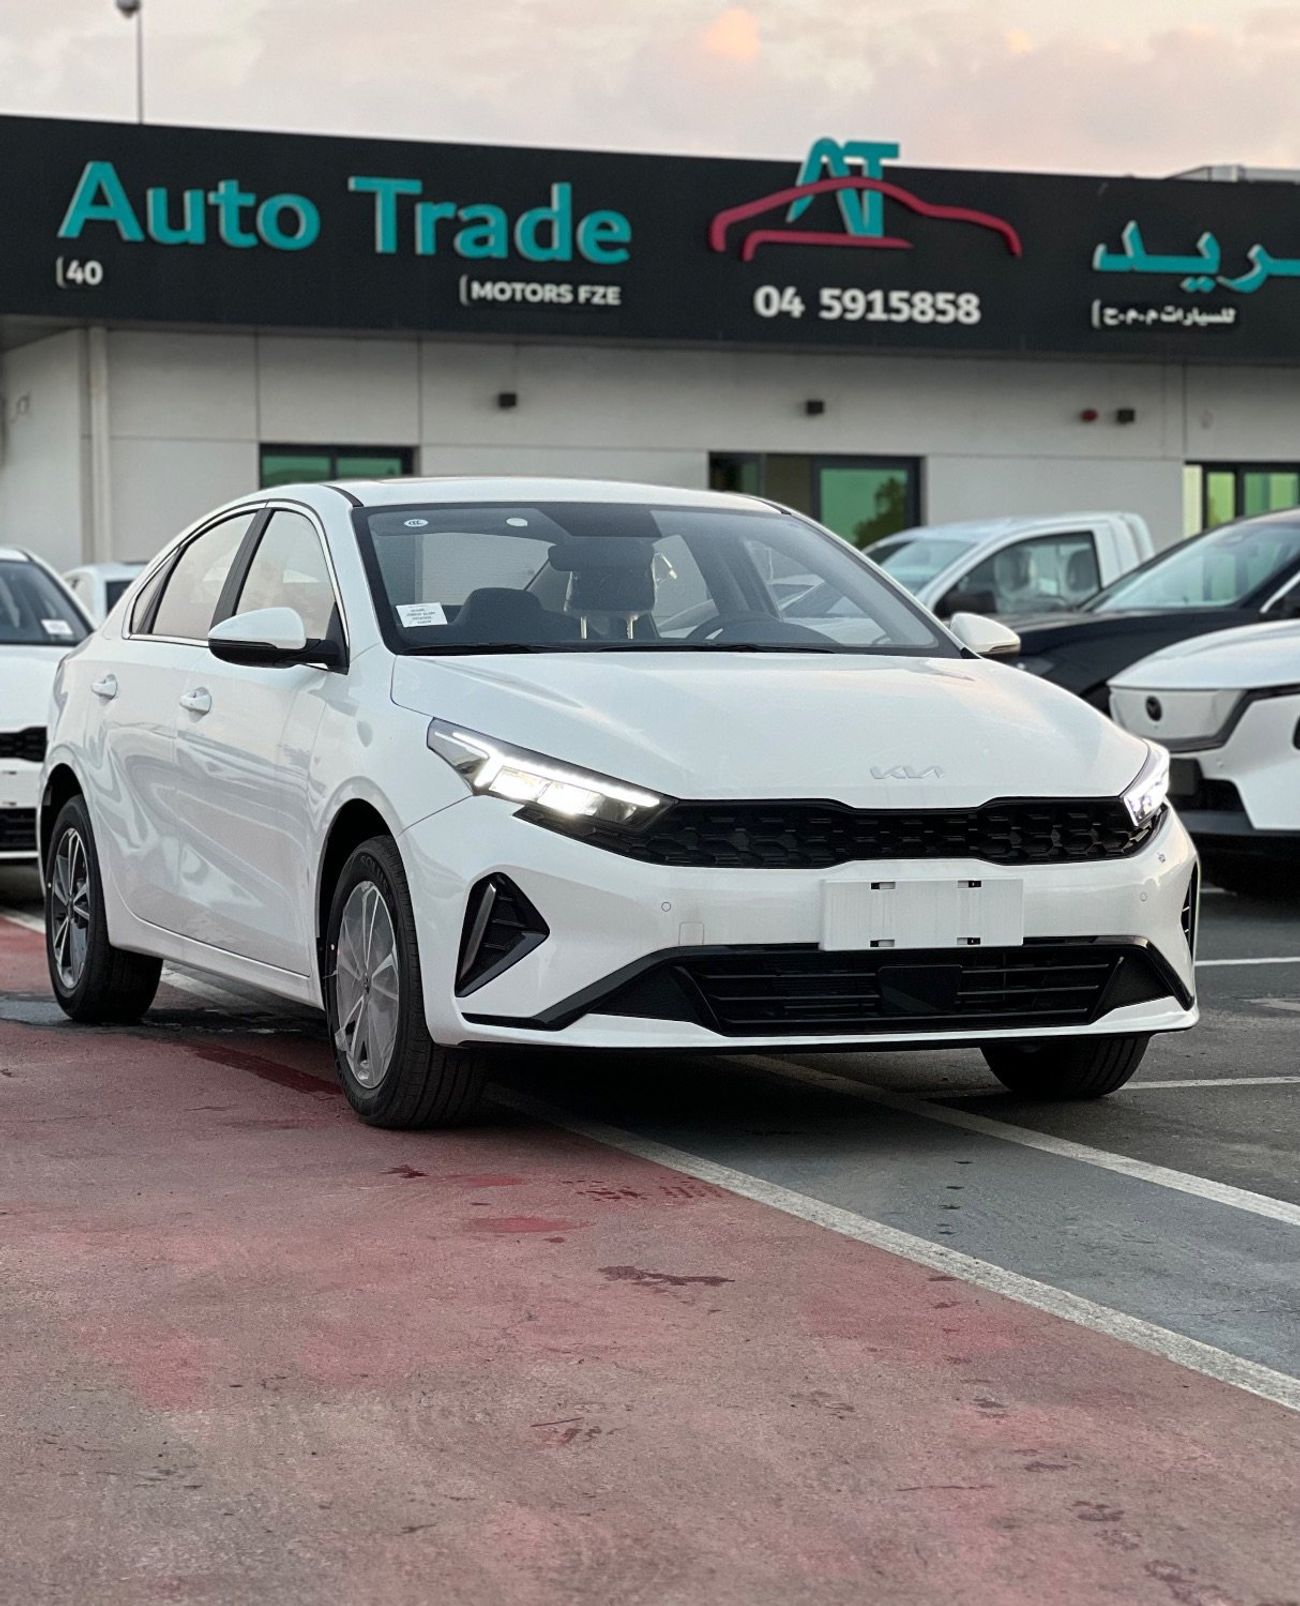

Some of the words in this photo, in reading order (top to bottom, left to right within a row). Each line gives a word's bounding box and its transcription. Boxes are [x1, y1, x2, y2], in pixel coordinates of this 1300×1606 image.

[58, 160, 320, 251] Auto
[348, 175, 632, 265] Trade
[788, 138, 899, 236] AT
[578, 285, 621, 306] FZE
[754, 285, 805, 318] 04
[819, 287, 981, 325] 5915858
